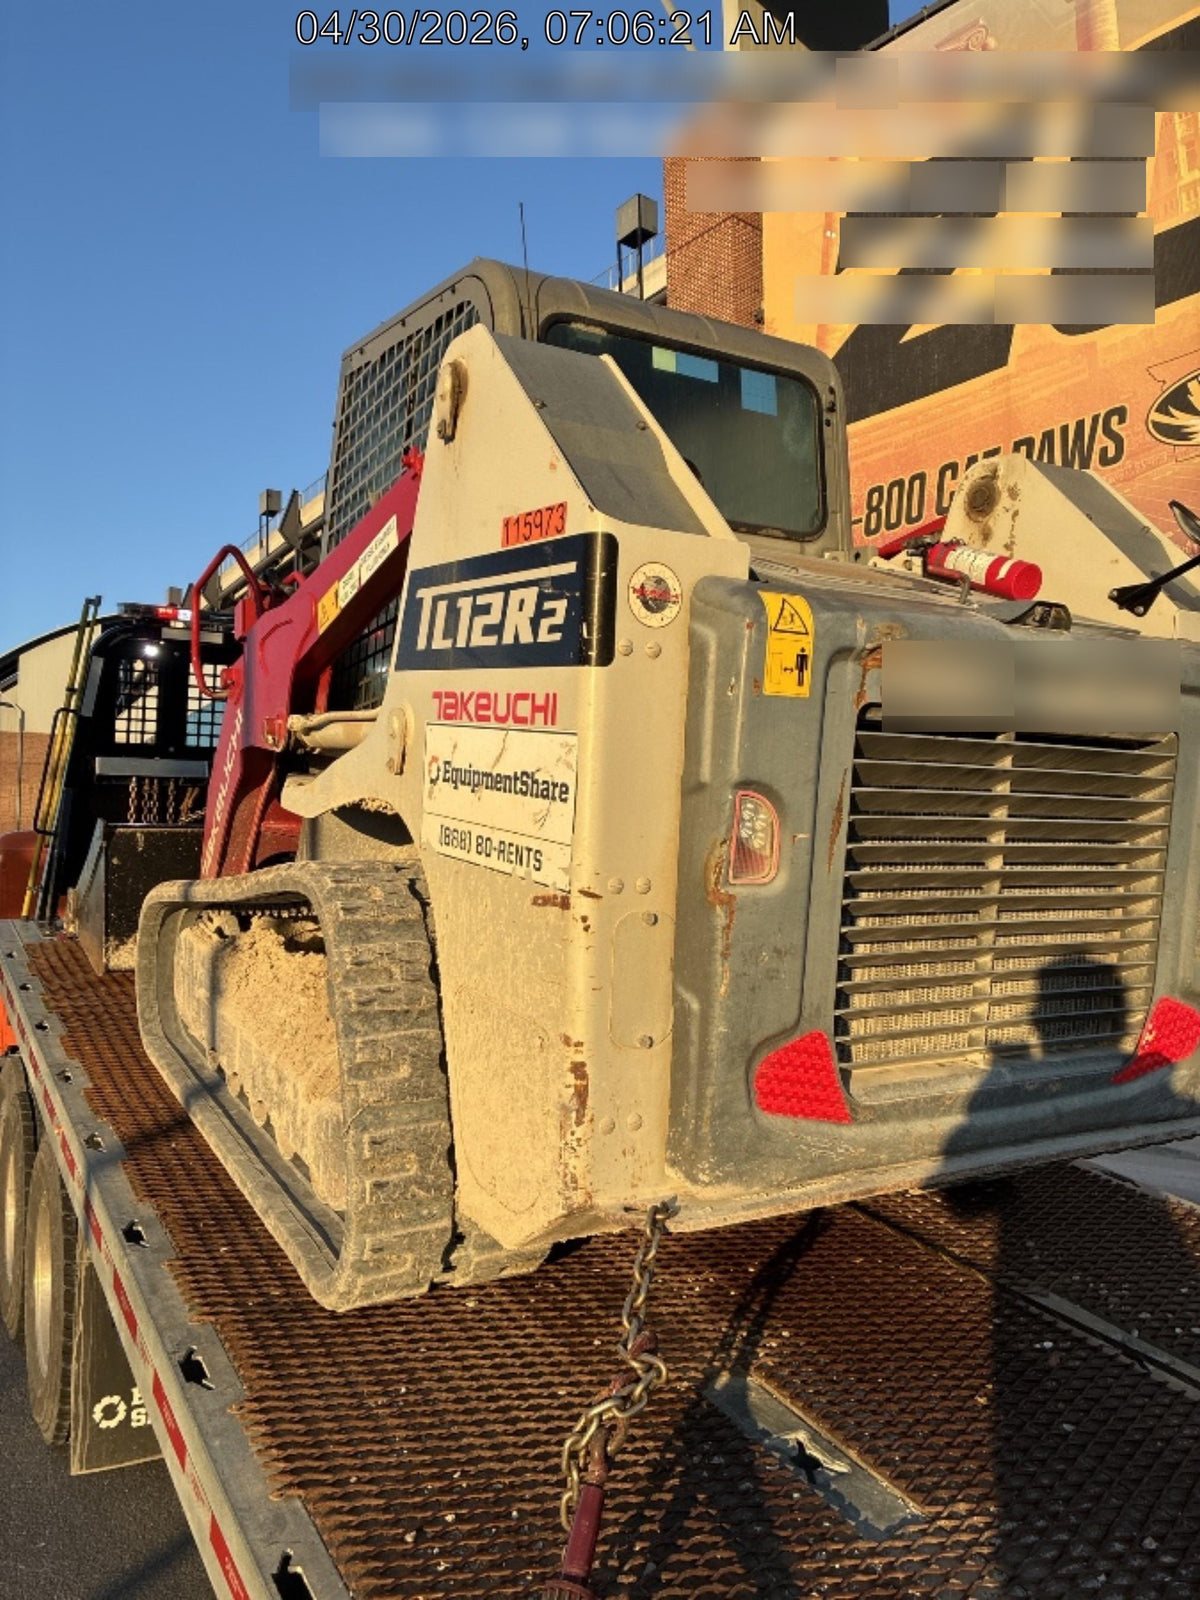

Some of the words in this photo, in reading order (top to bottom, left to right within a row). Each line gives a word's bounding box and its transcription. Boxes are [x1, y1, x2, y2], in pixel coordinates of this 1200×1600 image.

[503, 503, 566, 545] 115973
[415, 562, 577, 651] TL12R2
[442, 760, 570, 804] EquipmentShare
[475, 834, 543, 872] 80-RENTS
